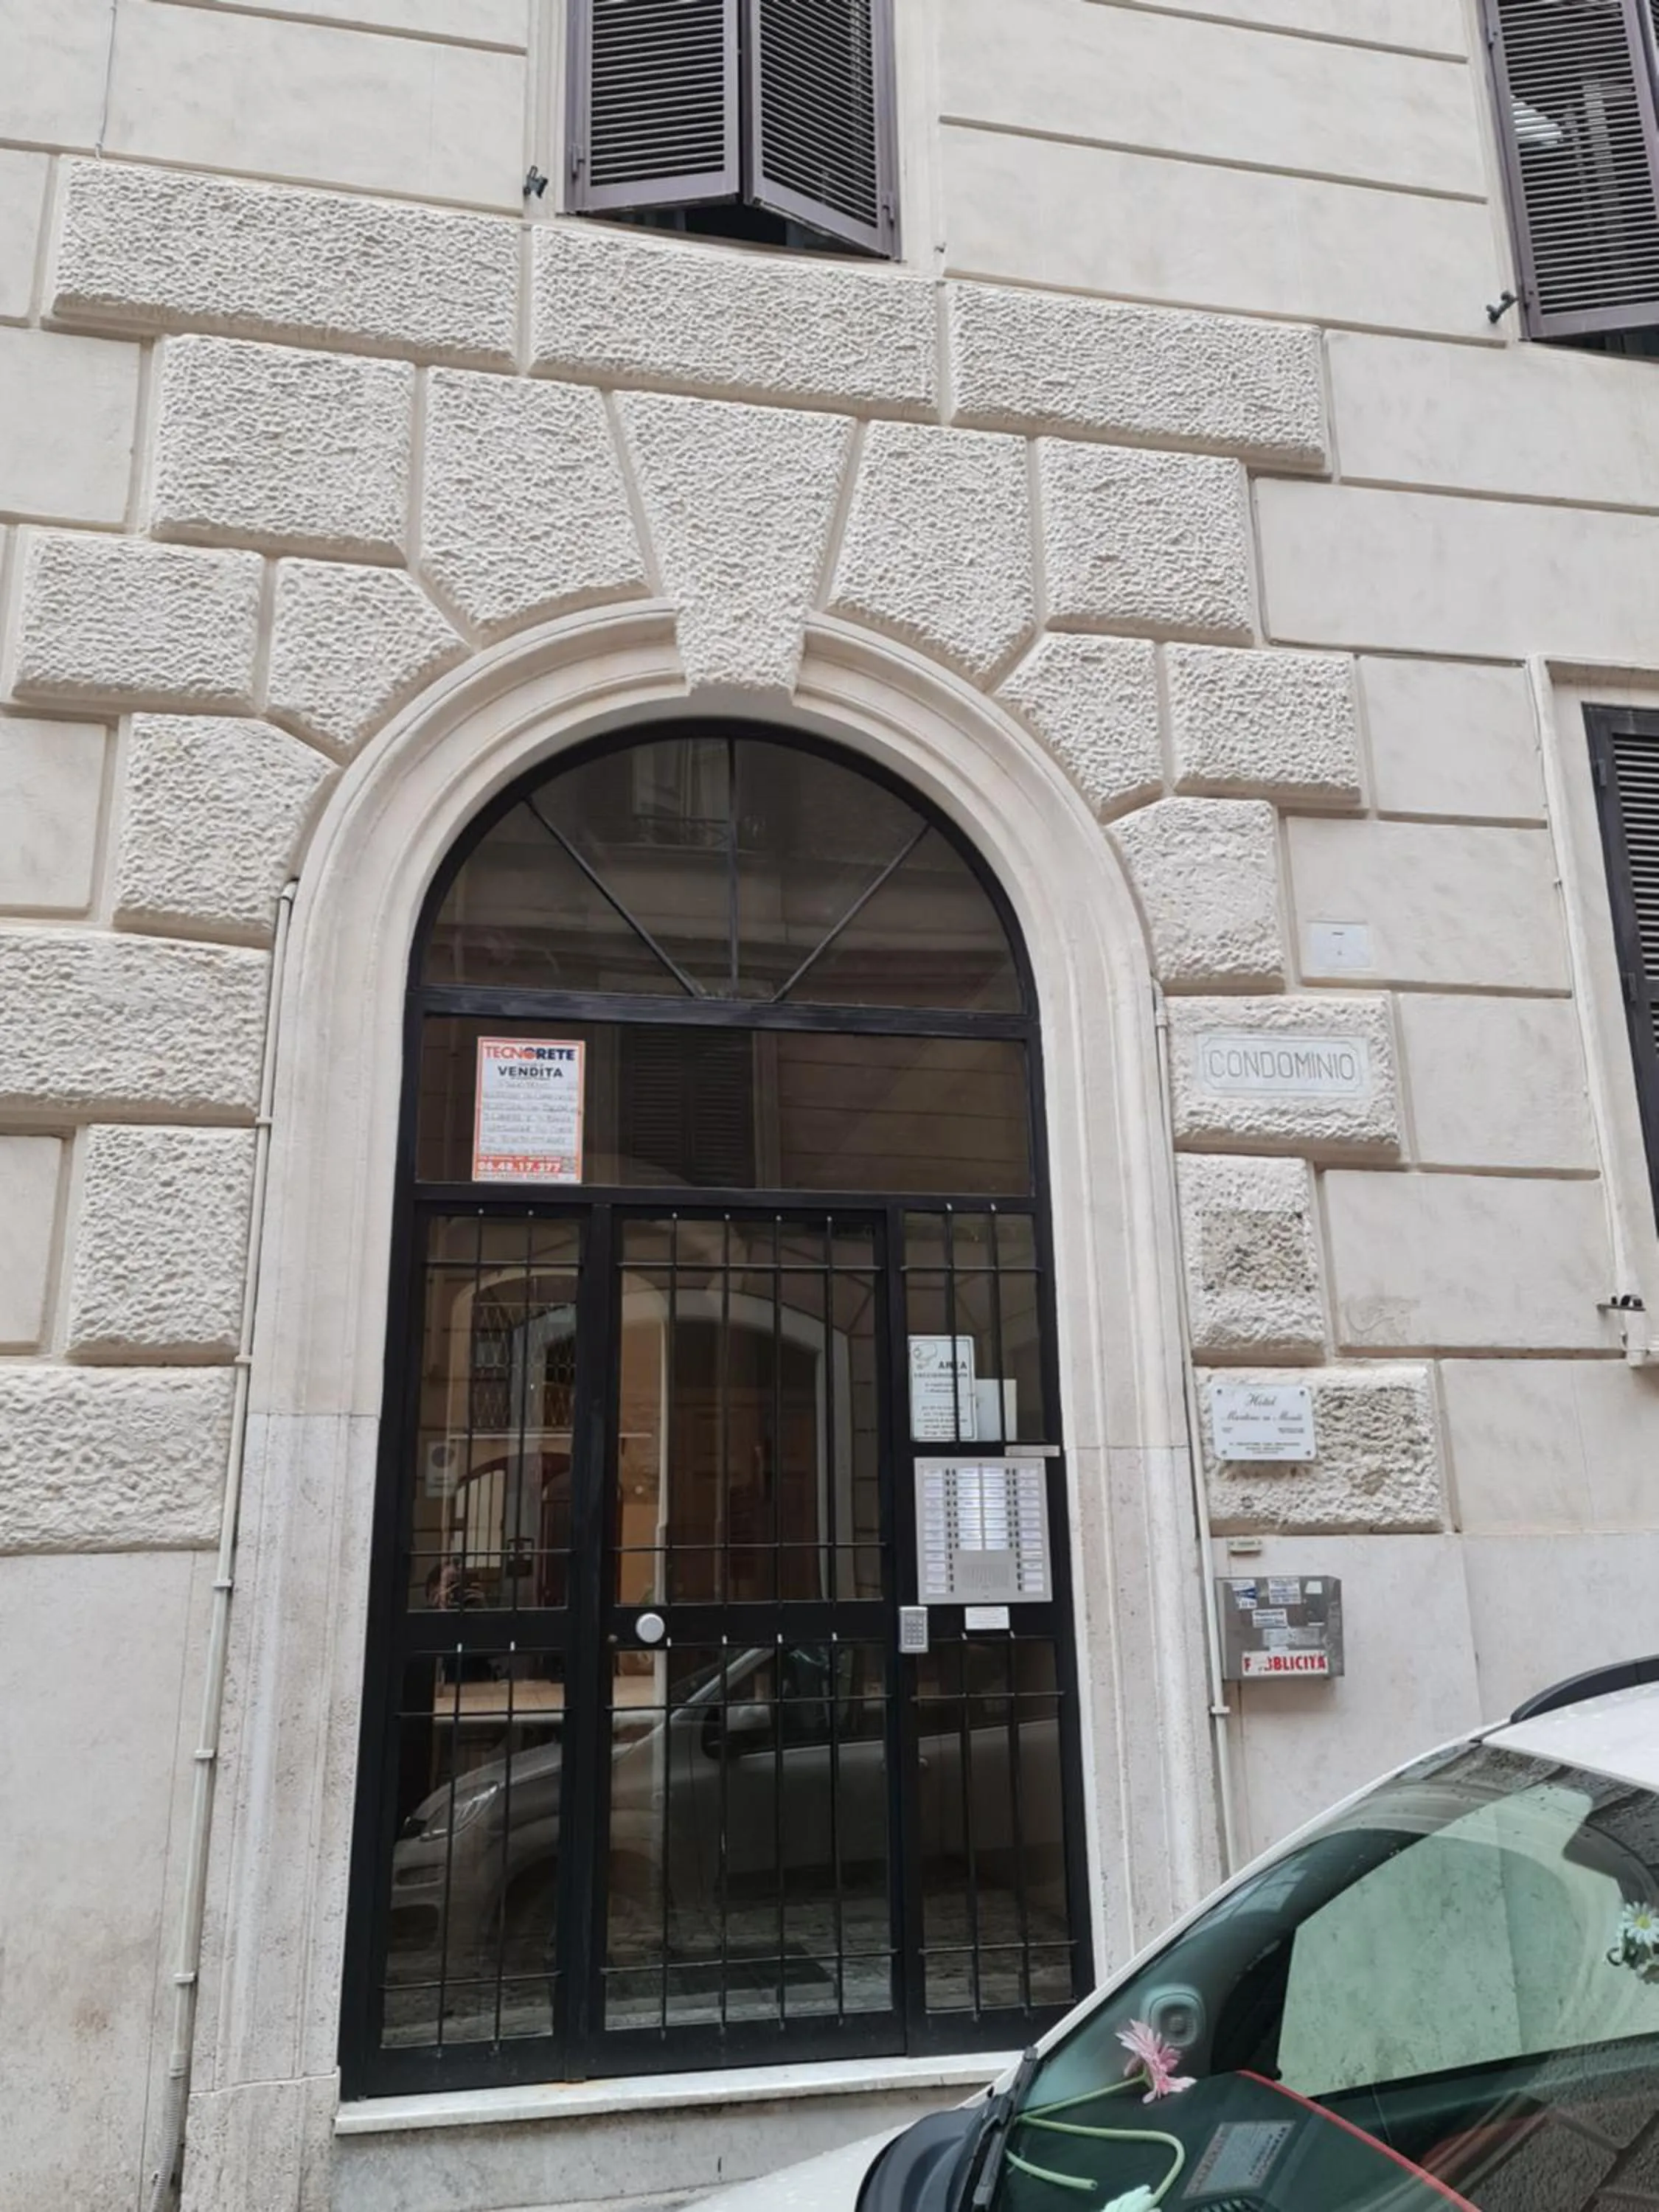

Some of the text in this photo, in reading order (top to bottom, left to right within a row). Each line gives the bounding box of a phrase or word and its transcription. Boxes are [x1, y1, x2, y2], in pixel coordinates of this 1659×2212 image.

[485, 1046, 576, 1060] TECNORETE
[497, 1065, 564, 1077] VENDITA
[1208, 1049, 1355, 1080] CONDOMINIO
